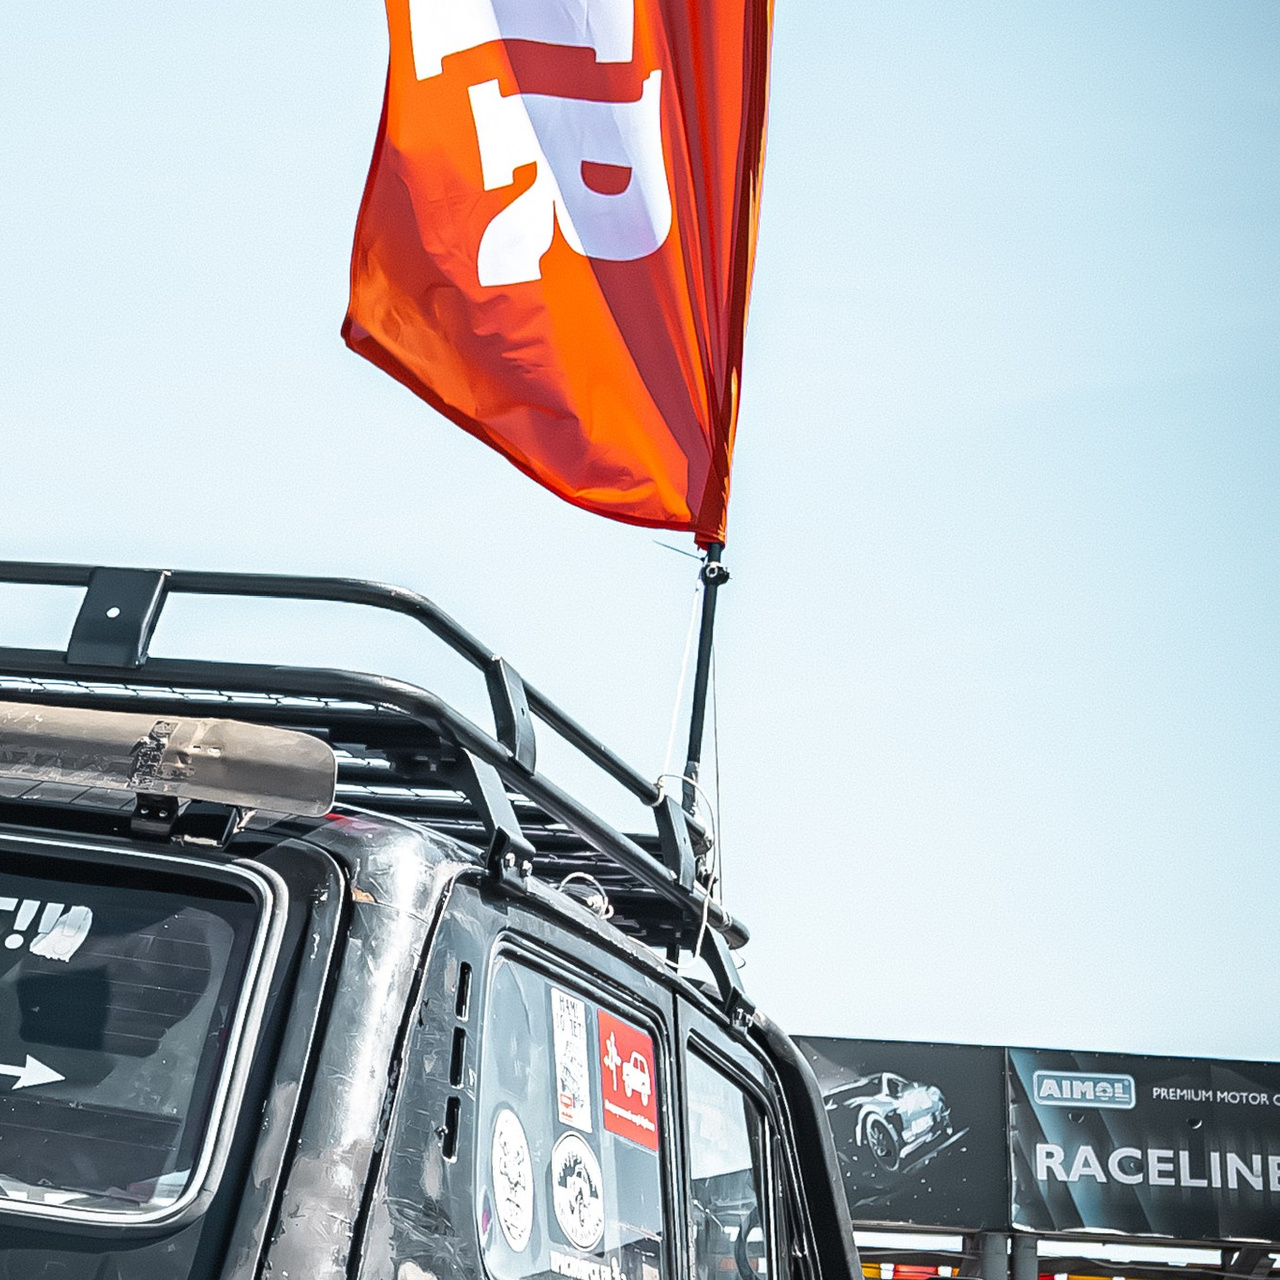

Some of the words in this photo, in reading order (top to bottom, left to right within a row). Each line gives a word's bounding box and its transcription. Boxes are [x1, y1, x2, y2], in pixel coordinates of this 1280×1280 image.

[1039, 1078, 1130, 1102] AIMOL
[1152, 1087, 1213, 1102] PREMIUM
[1217, 1090, 1269, 1105] MOTOR
